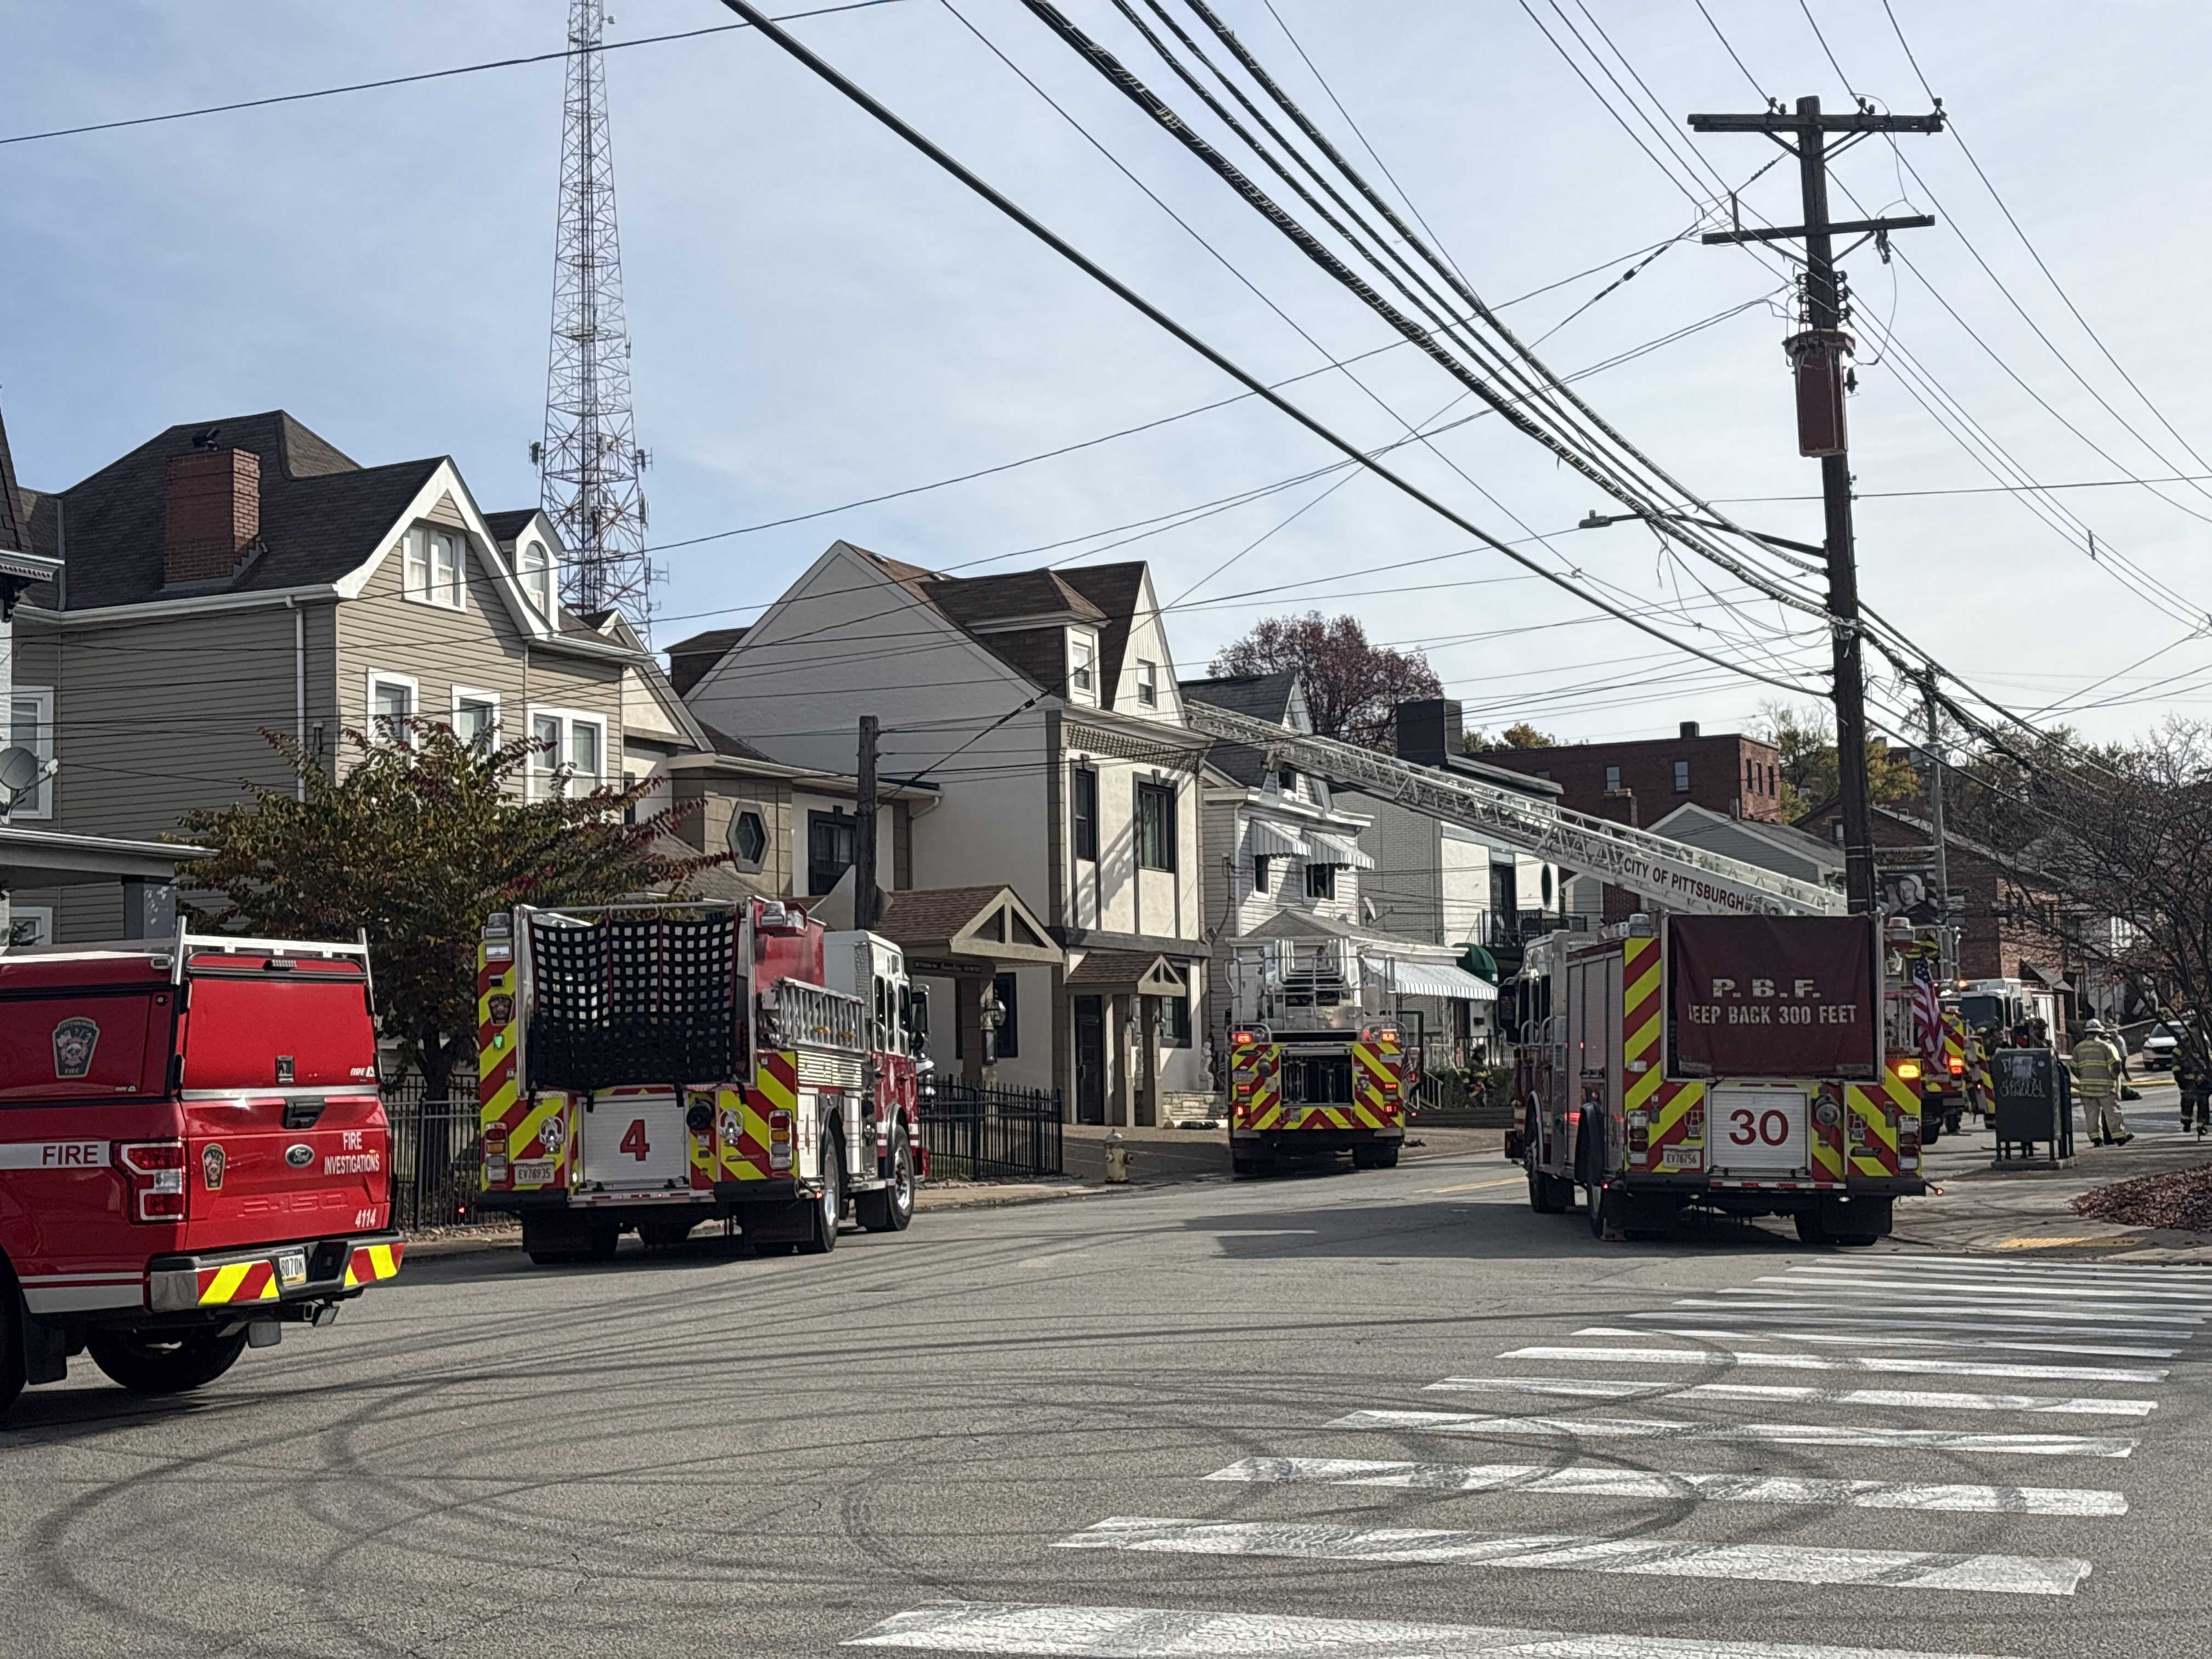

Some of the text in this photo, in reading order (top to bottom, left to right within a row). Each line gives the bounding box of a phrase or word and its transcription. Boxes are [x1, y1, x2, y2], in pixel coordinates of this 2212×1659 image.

[1624, 857, 1745, 911] CITY OF PITTSBURGH
[1728, 1006, 1771, 1024] BACK
[1779, 1006, 1811, 1024] 300
[1819, 1005, 1857, 1024] FEET
[1729, 1109, 1788, 1146] 30
[342, 1132, 363, 1150] FIRE
[620, 1119, 650, 1161] 4
[43, 1144, 98, 1165] FIRE
[324, 1154, 380, 1175] INVESTIGATIONS
[355, 1208, 377, 1228] 4114
